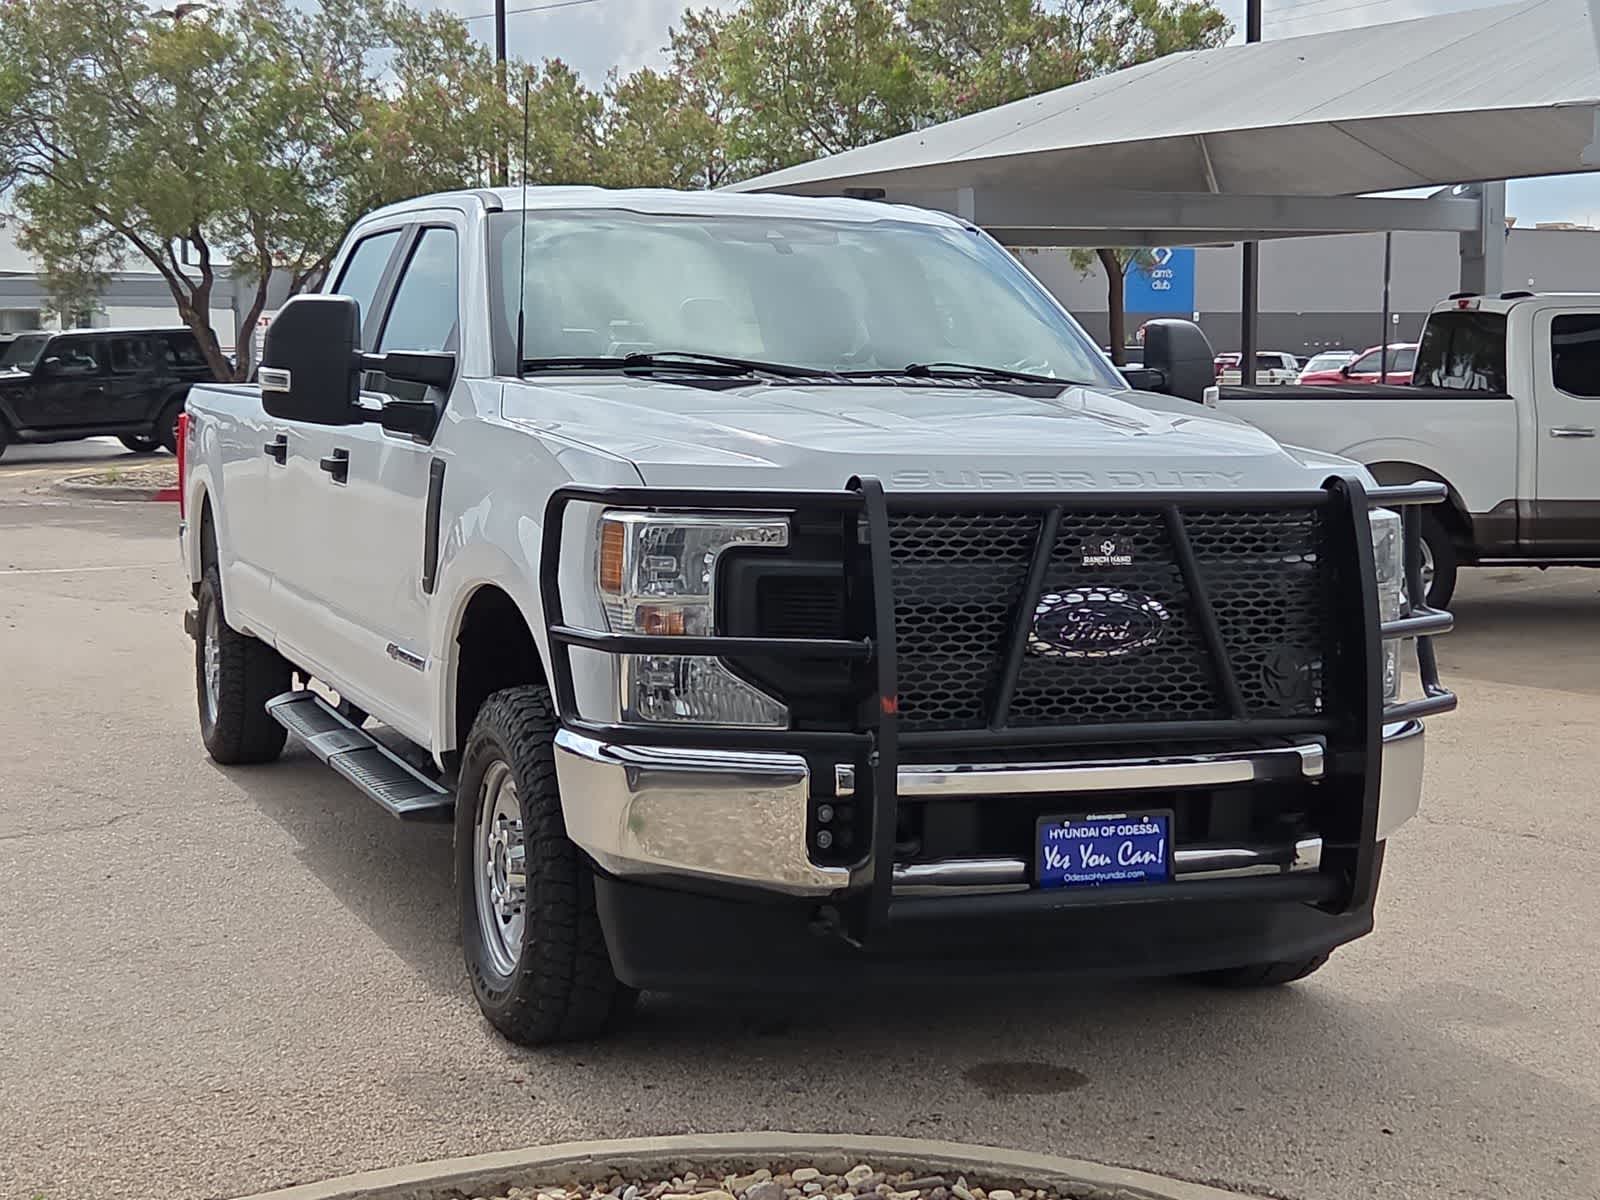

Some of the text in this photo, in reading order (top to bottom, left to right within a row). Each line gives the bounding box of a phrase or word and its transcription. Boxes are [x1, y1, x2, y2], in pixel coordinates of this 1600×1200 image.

[890, 470, 1244, 489] SUPER DUTY
[1083, 555, 1132, 563] RANCH HAND
[1059, 611, 1131, 641] Ford
[1049, 823, 1160, 840] HYUNDAI OF ODESSA
[1044, 838, 1164, 870] Yes You Can!
[1063, 870, 1145, 882] OdessaHyundai.com
